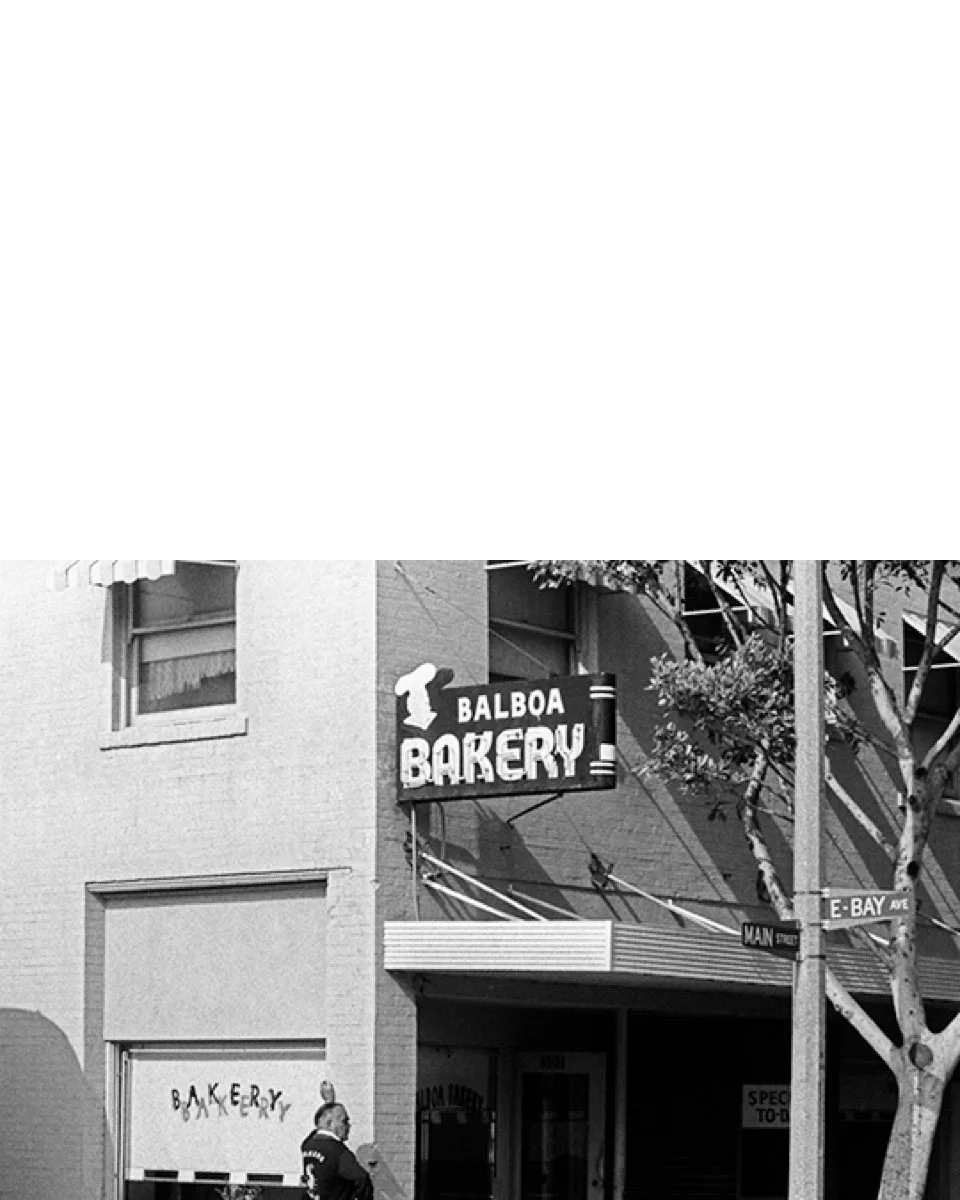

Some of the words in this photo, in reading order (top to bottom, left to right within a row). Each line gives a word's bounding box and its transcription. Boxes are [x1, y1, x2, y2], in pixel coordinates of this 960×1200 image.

[458, 688, 565, 723] BALBOA
[400, 722, 585, 789] BAKERY
[829, 895, 886, 918] E-BAY
[890, 898, 909, 910] AVE
[744, 924, 774, 947] MAIN
[776, 932, 799, 945] STREET
[171, 1082, 283, 1112] BAKERY
